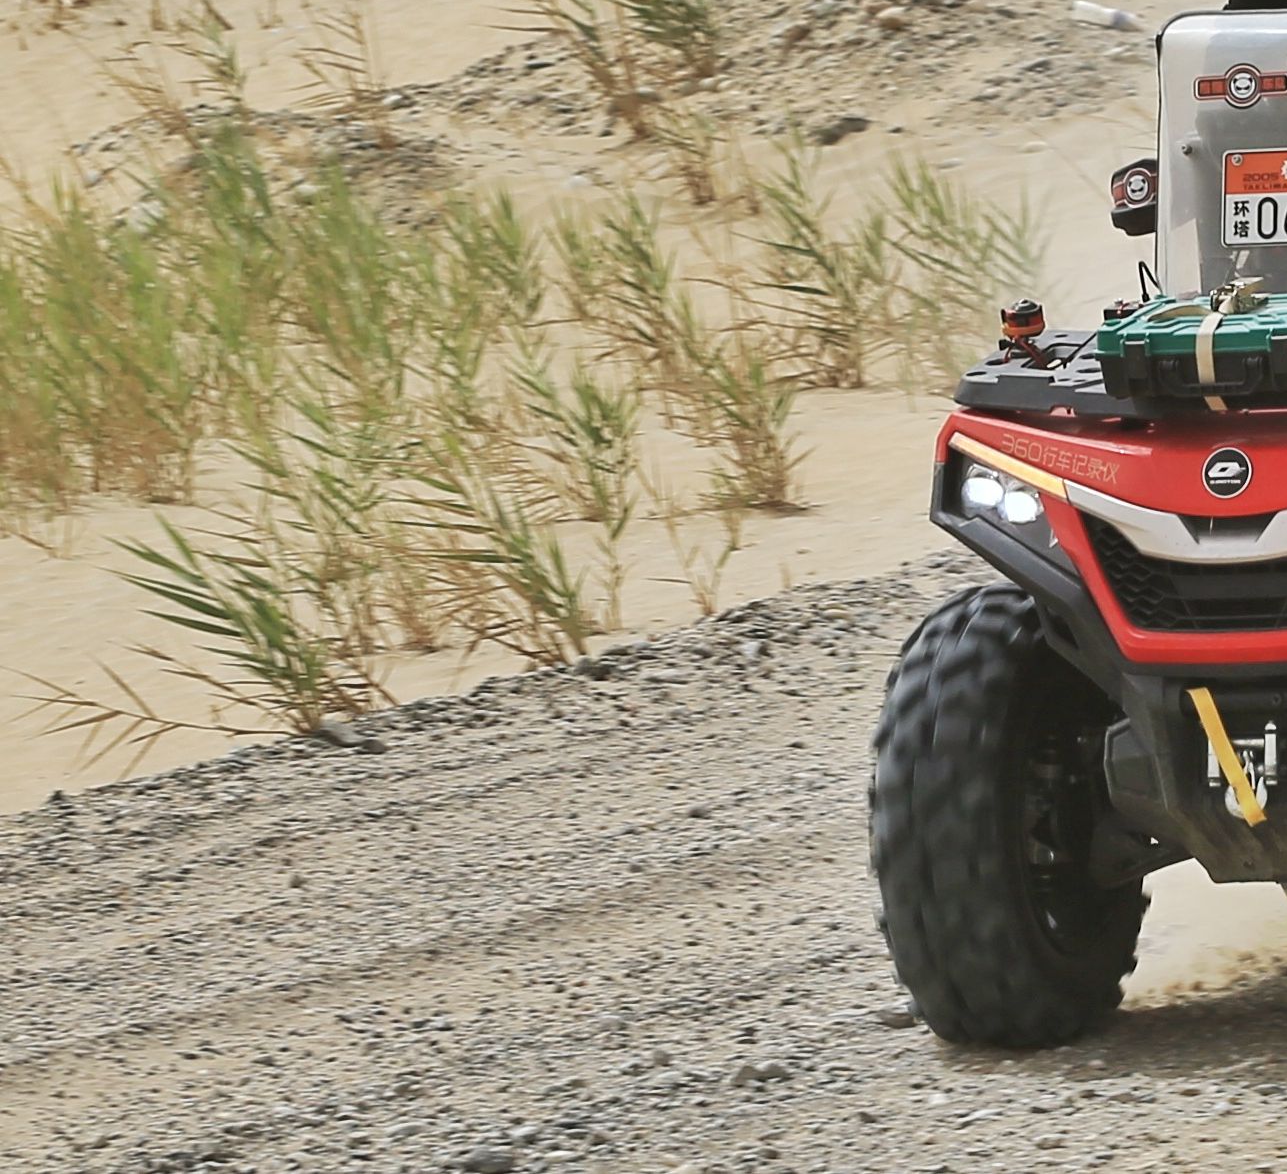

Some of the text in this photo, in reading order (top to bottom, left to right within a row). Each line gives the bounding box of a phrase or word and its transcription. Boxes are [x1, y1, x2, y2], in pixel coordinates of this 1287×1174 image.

[1243, 172, 1279, 183] 2005
[1233, 200, 1250, 238] 环塔
[1001, 433, 1121, 486] 360行车记录仪
